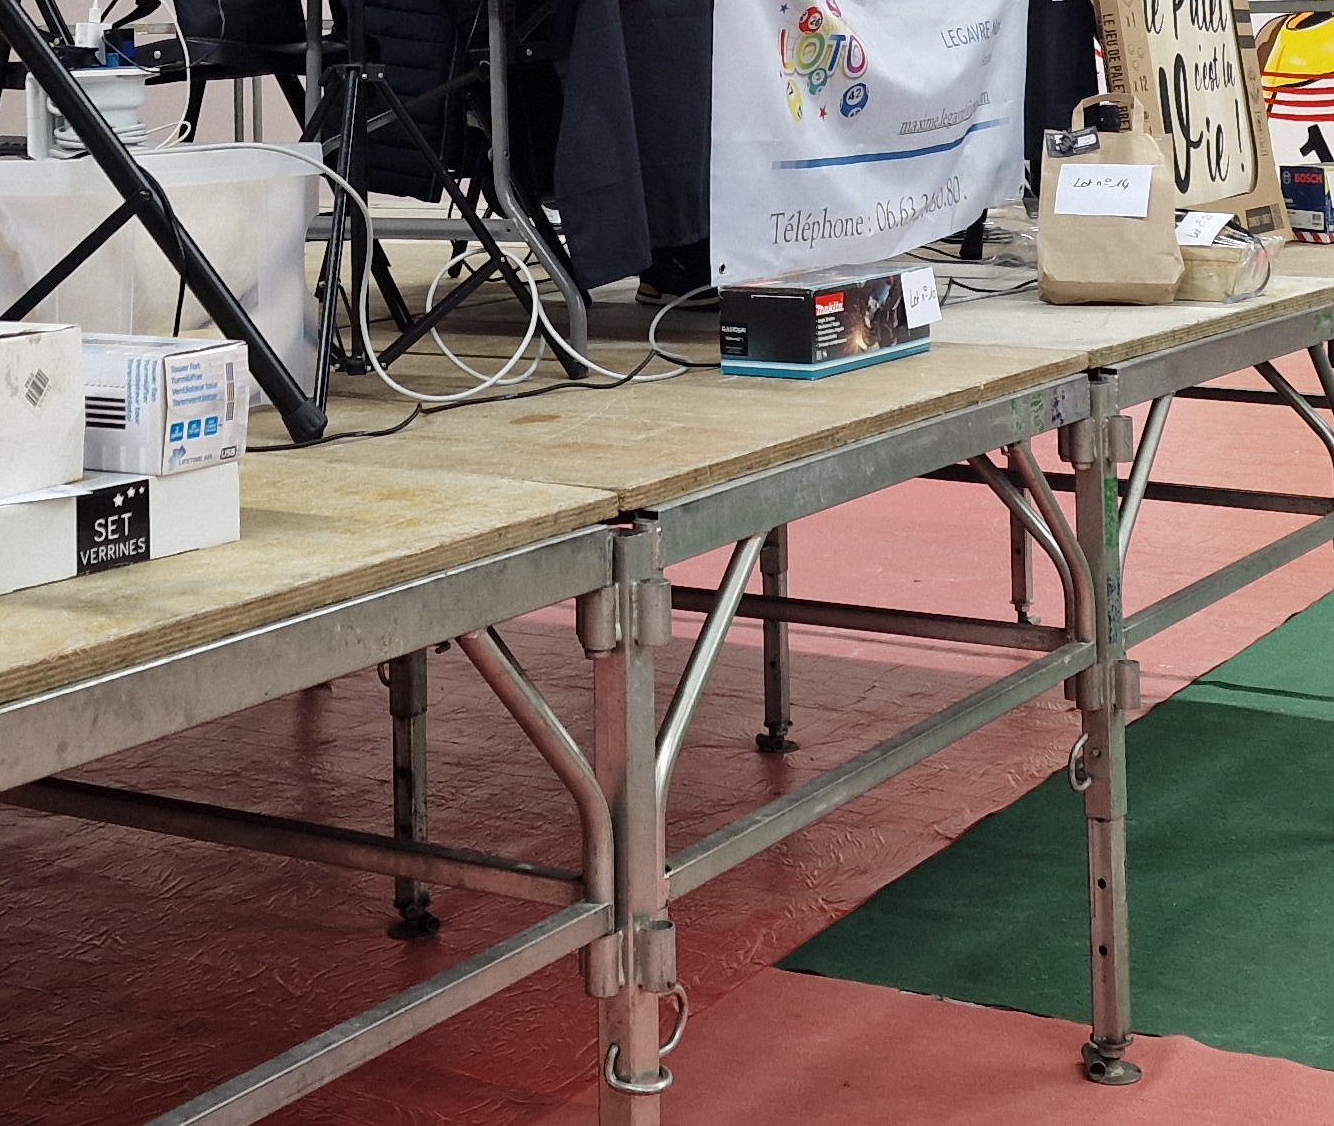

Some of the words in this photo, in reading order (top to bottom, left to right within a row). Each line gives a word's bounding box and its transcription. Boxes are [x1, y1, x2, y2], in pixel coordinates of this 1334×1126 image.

[1102, 12, 1116, 28] LE
[940, 20, 991, 49] LEGAVRE
[1104, 29, 1119, 47] JEU
[778, 28, 868, 78] LOTO
[1107, 48, 1121, 63] DE
[1109, 64, 1126, 95] PALET
[847, 87, 863, 101] 42
[1158, 52, 1231, 195] Vie
[1072, 177, 1093, 188] Lot
[1113, 178, 1130, 190] 14
[1293, 172, 1324, 184] BOSCH
[770, 207, 864, 249] Téléphone
[909, 288, 920, 309] Lot
[171, 364, 190, 374] Tower
[189, 362, 201, 371] fan
[93, 511, 134, 544] SET
[80, 536, 147, 567] VERRINES
